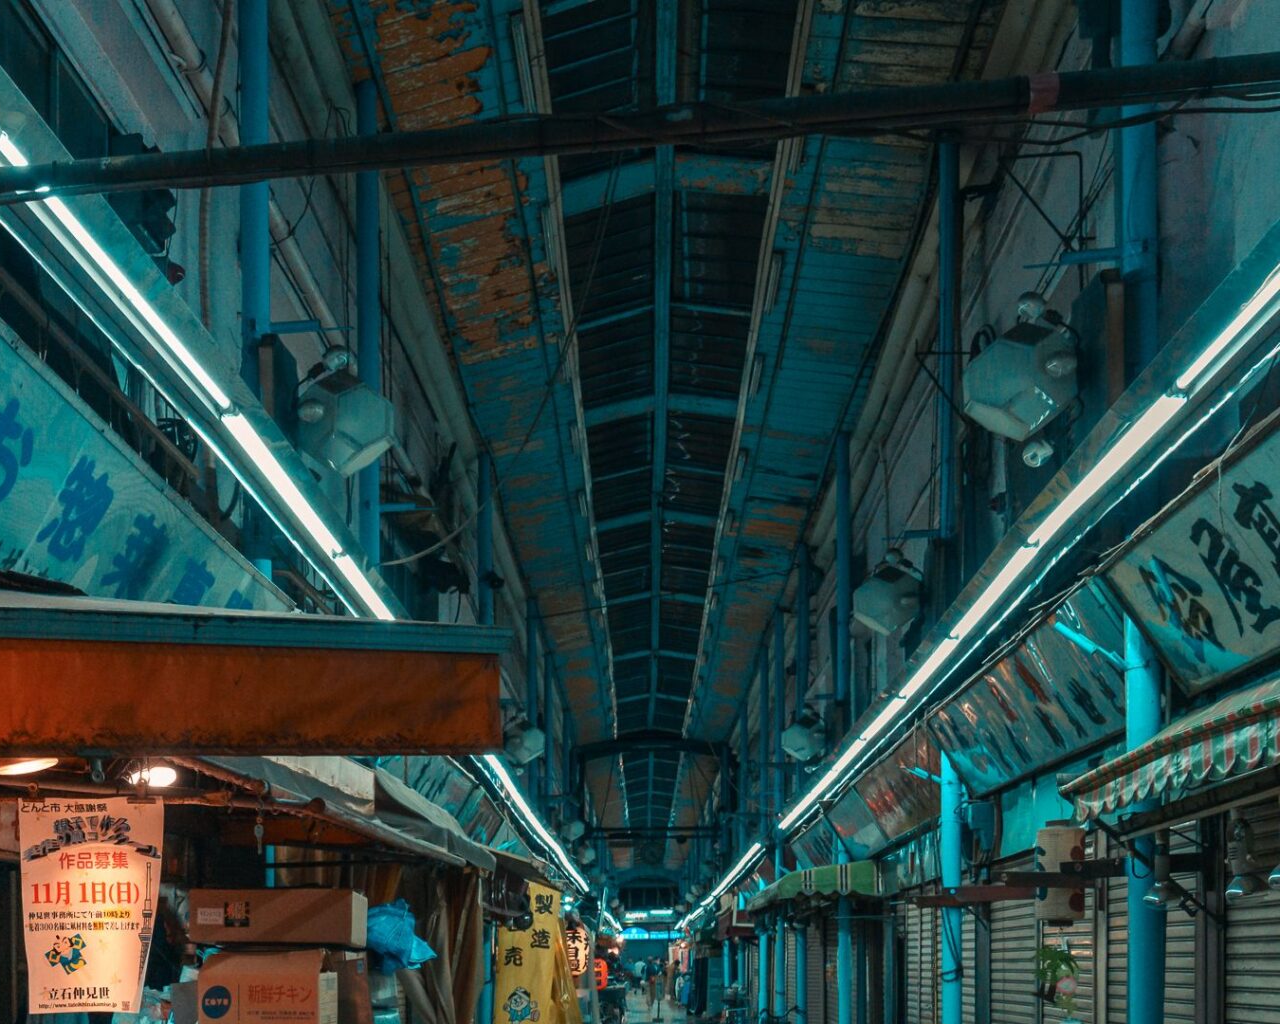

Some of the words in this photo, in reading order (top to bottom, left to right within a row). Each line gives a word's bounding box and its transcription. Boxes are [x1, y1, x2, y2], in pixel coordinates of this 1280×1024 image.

[21, 803, 61, 813] どんと市
[59, 852, 129, 869] 作品募集
[48, 987, 110, 1000] 立石仲見世
[247, 984, 313, 1004] 新鮮チキン
